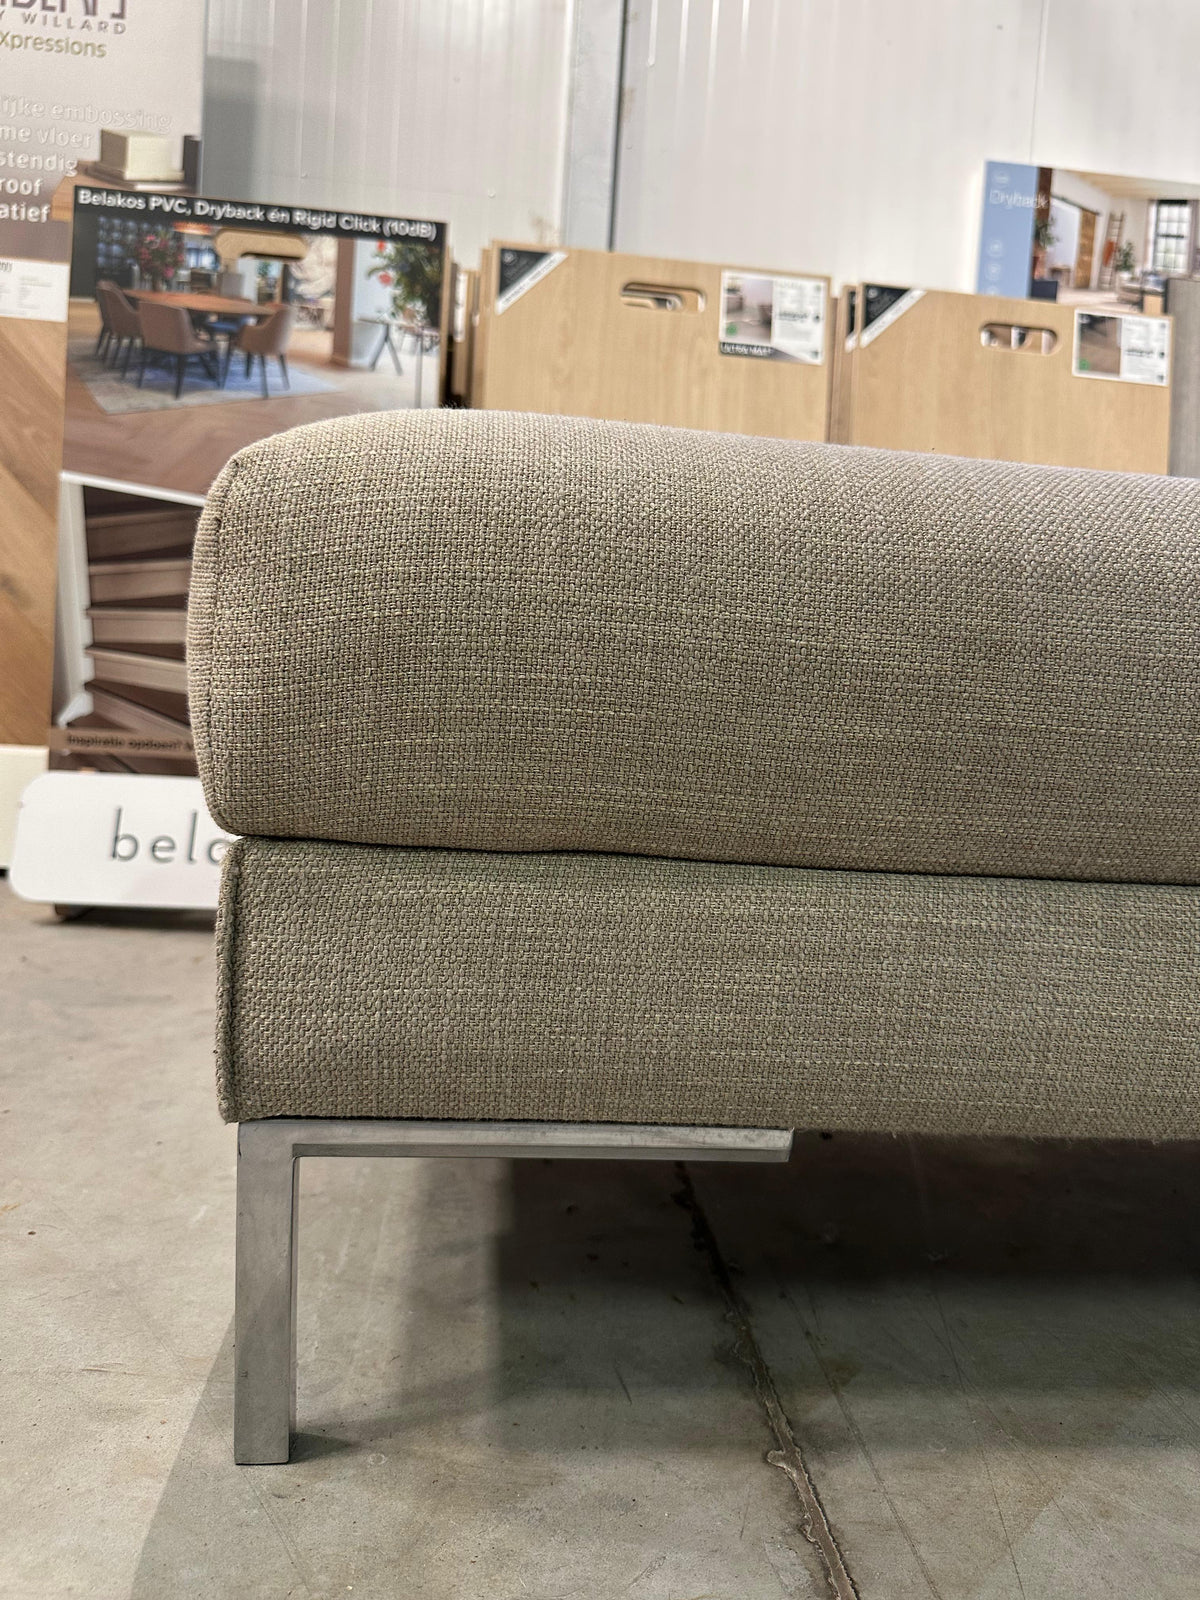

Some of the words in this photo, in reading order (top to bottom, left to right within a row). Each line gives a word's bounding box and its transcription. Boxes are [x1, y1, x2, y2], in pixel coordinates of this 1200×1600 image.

[22, 12, 126, 35] WILLARD
[51, 105, 172, 134] embossing
[78, 188, 147, 210] Belakos
[149, 195, 192, 216] PVC,
[194, 200, 265, 221] Dryback
[292, 209, 337, 230] Rigid
[338, 214, 381, 234] Click
